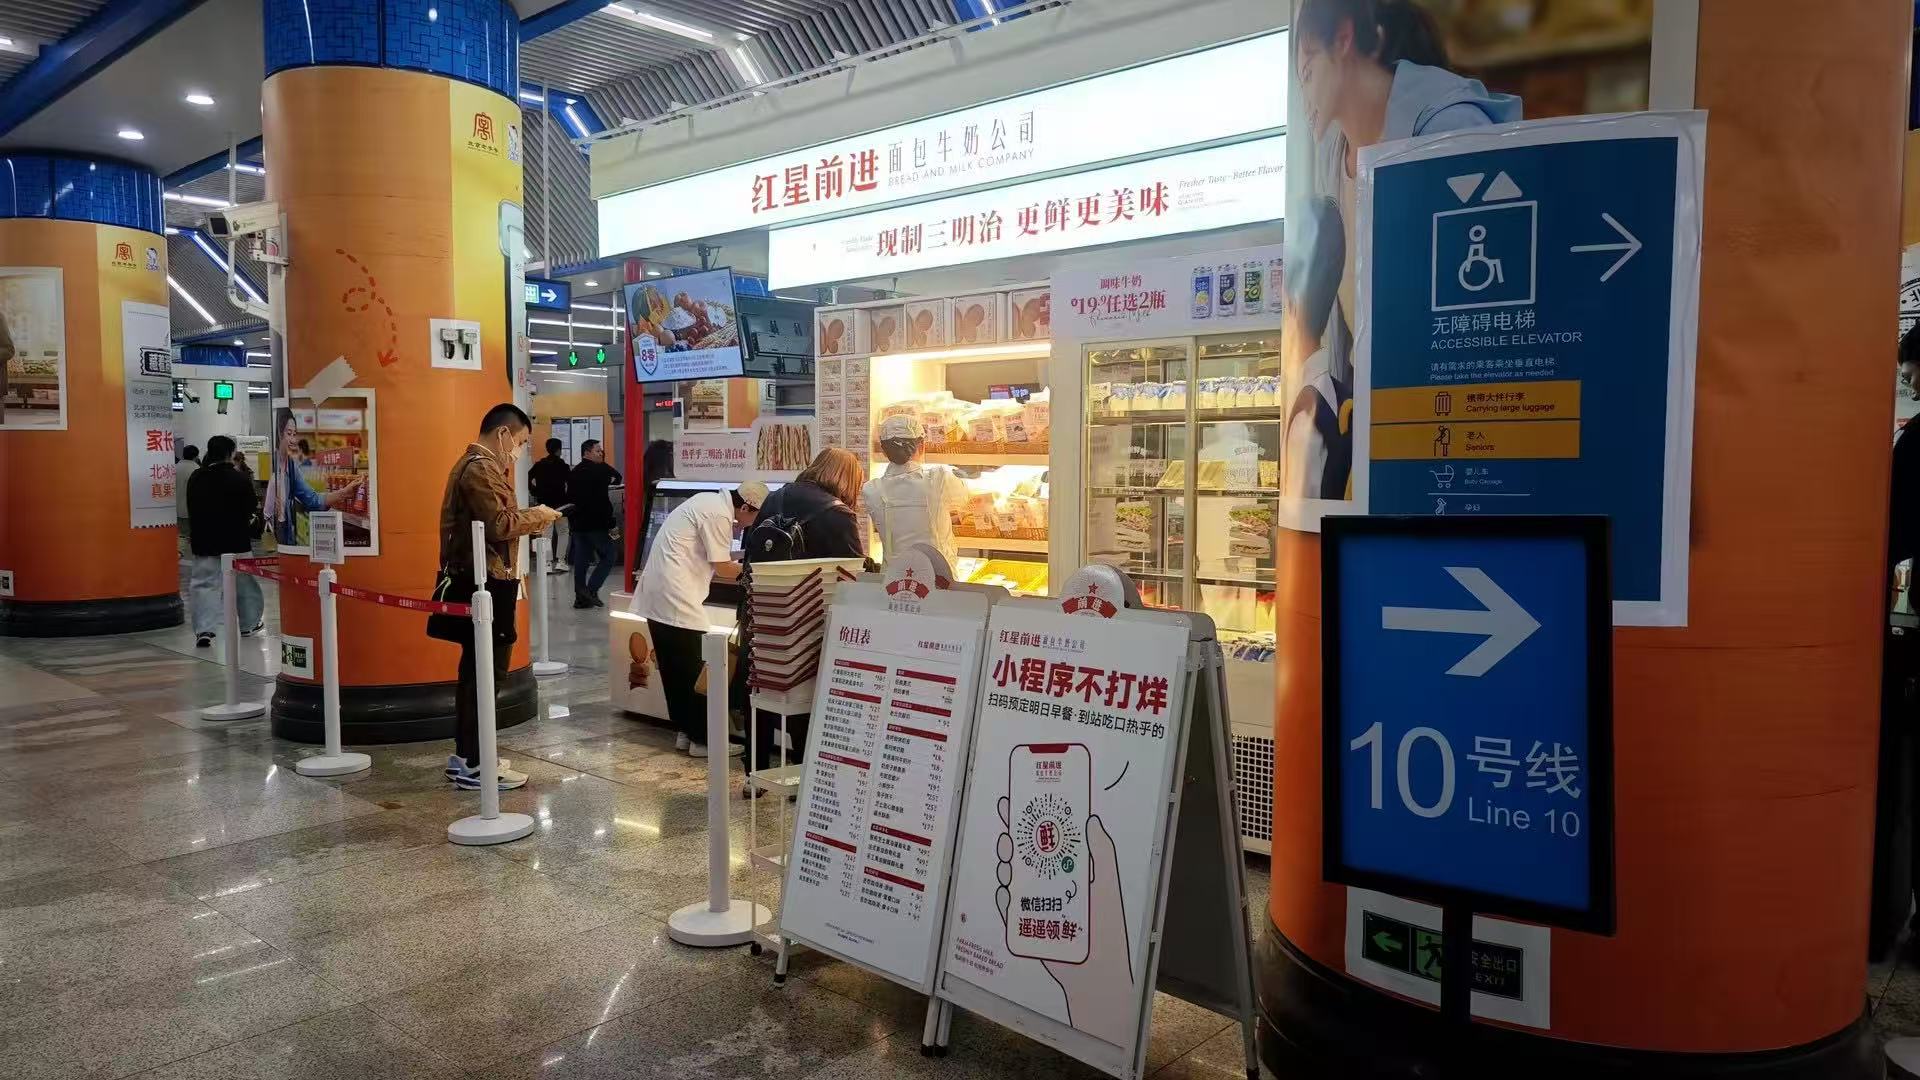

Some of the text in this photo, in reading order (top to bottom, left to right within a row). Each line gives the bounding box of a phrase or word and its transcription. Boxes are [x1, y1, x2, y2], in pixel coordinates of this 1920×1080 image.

[751, 111, 1034, 214] 红星前进 面包牛奶公司
[888, 148, 1035, 187] BREAD AND MILK COMPANY
[877, 181, 1169, 257] 现制三明治 更鲜更美味
[1432, 309, 1536, 336] 无障碍电梯
[1431, 332, 1583, 350] ACCESSIBLE ELEVATOR
[1430, 373, 1453, 381] Please
[1454, 372, 1469, 380] take
[1470, 371, 1482, 379] the
[1483, 370, 1513, 379] elevator
[1525, 368, 1555, 377] needed
[1465, 403, 1555, 413] Carrying large luggage
[1466, 432, 1485, 440] 老人
[1465, 443, 1495, 451] Seniors
[151, 483, 176, 498] 真果
[1077, 596, 1102, 612] 前进
[839, 626, 871, 645] 价目表
[1000, 630, 1041, 648] 红星前进
[992, 654, 1169, 715] 小程序不打烊
[1468, 796, 1580, 837] Line 10
[1020, 896, 1062, 912] 微信扫扫
[1018, 917, 1078, 941] 遥遥领鲜
